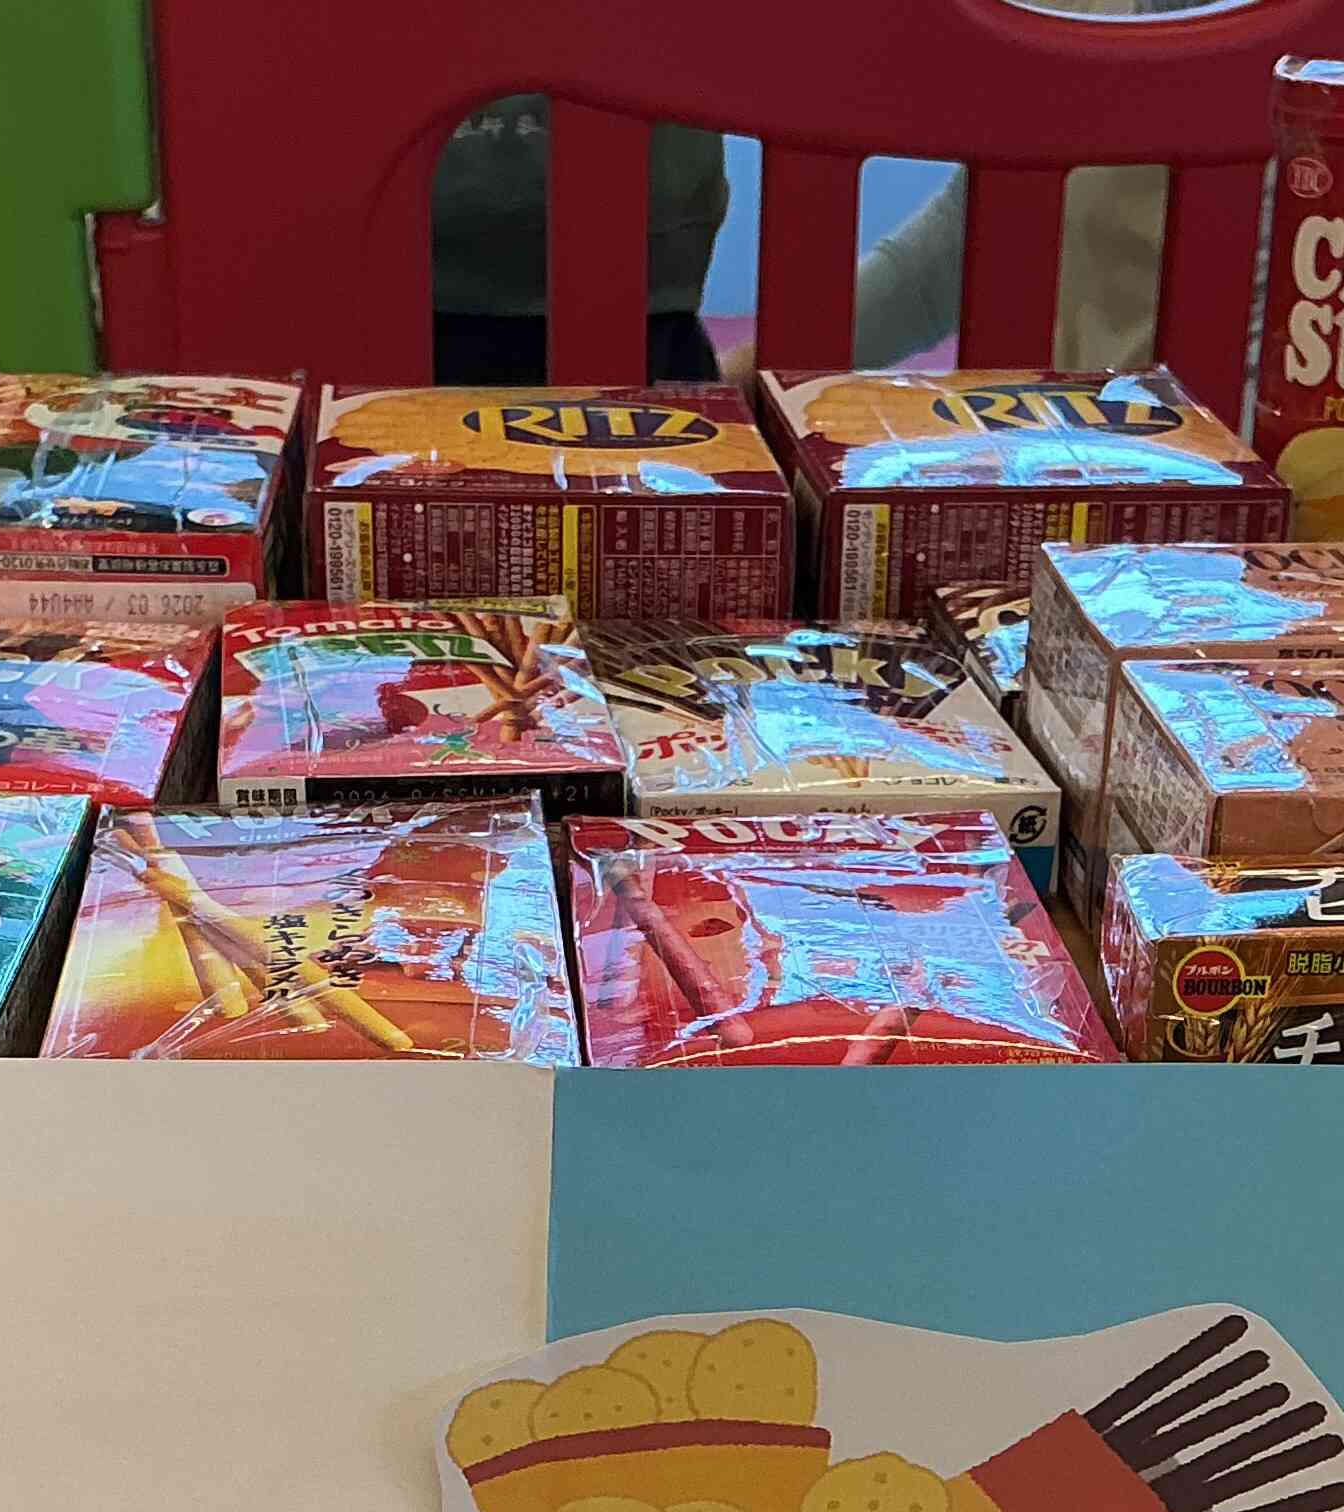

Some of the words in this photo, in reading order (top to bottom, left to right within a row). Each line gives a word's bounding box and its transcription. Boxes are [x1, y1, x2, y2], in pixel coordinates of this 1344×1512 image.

[474, 406, 714, 442] RITZ
[232, 617, 455, 643] Tomato
[1182, 977, 1269, 998] BOURBON
